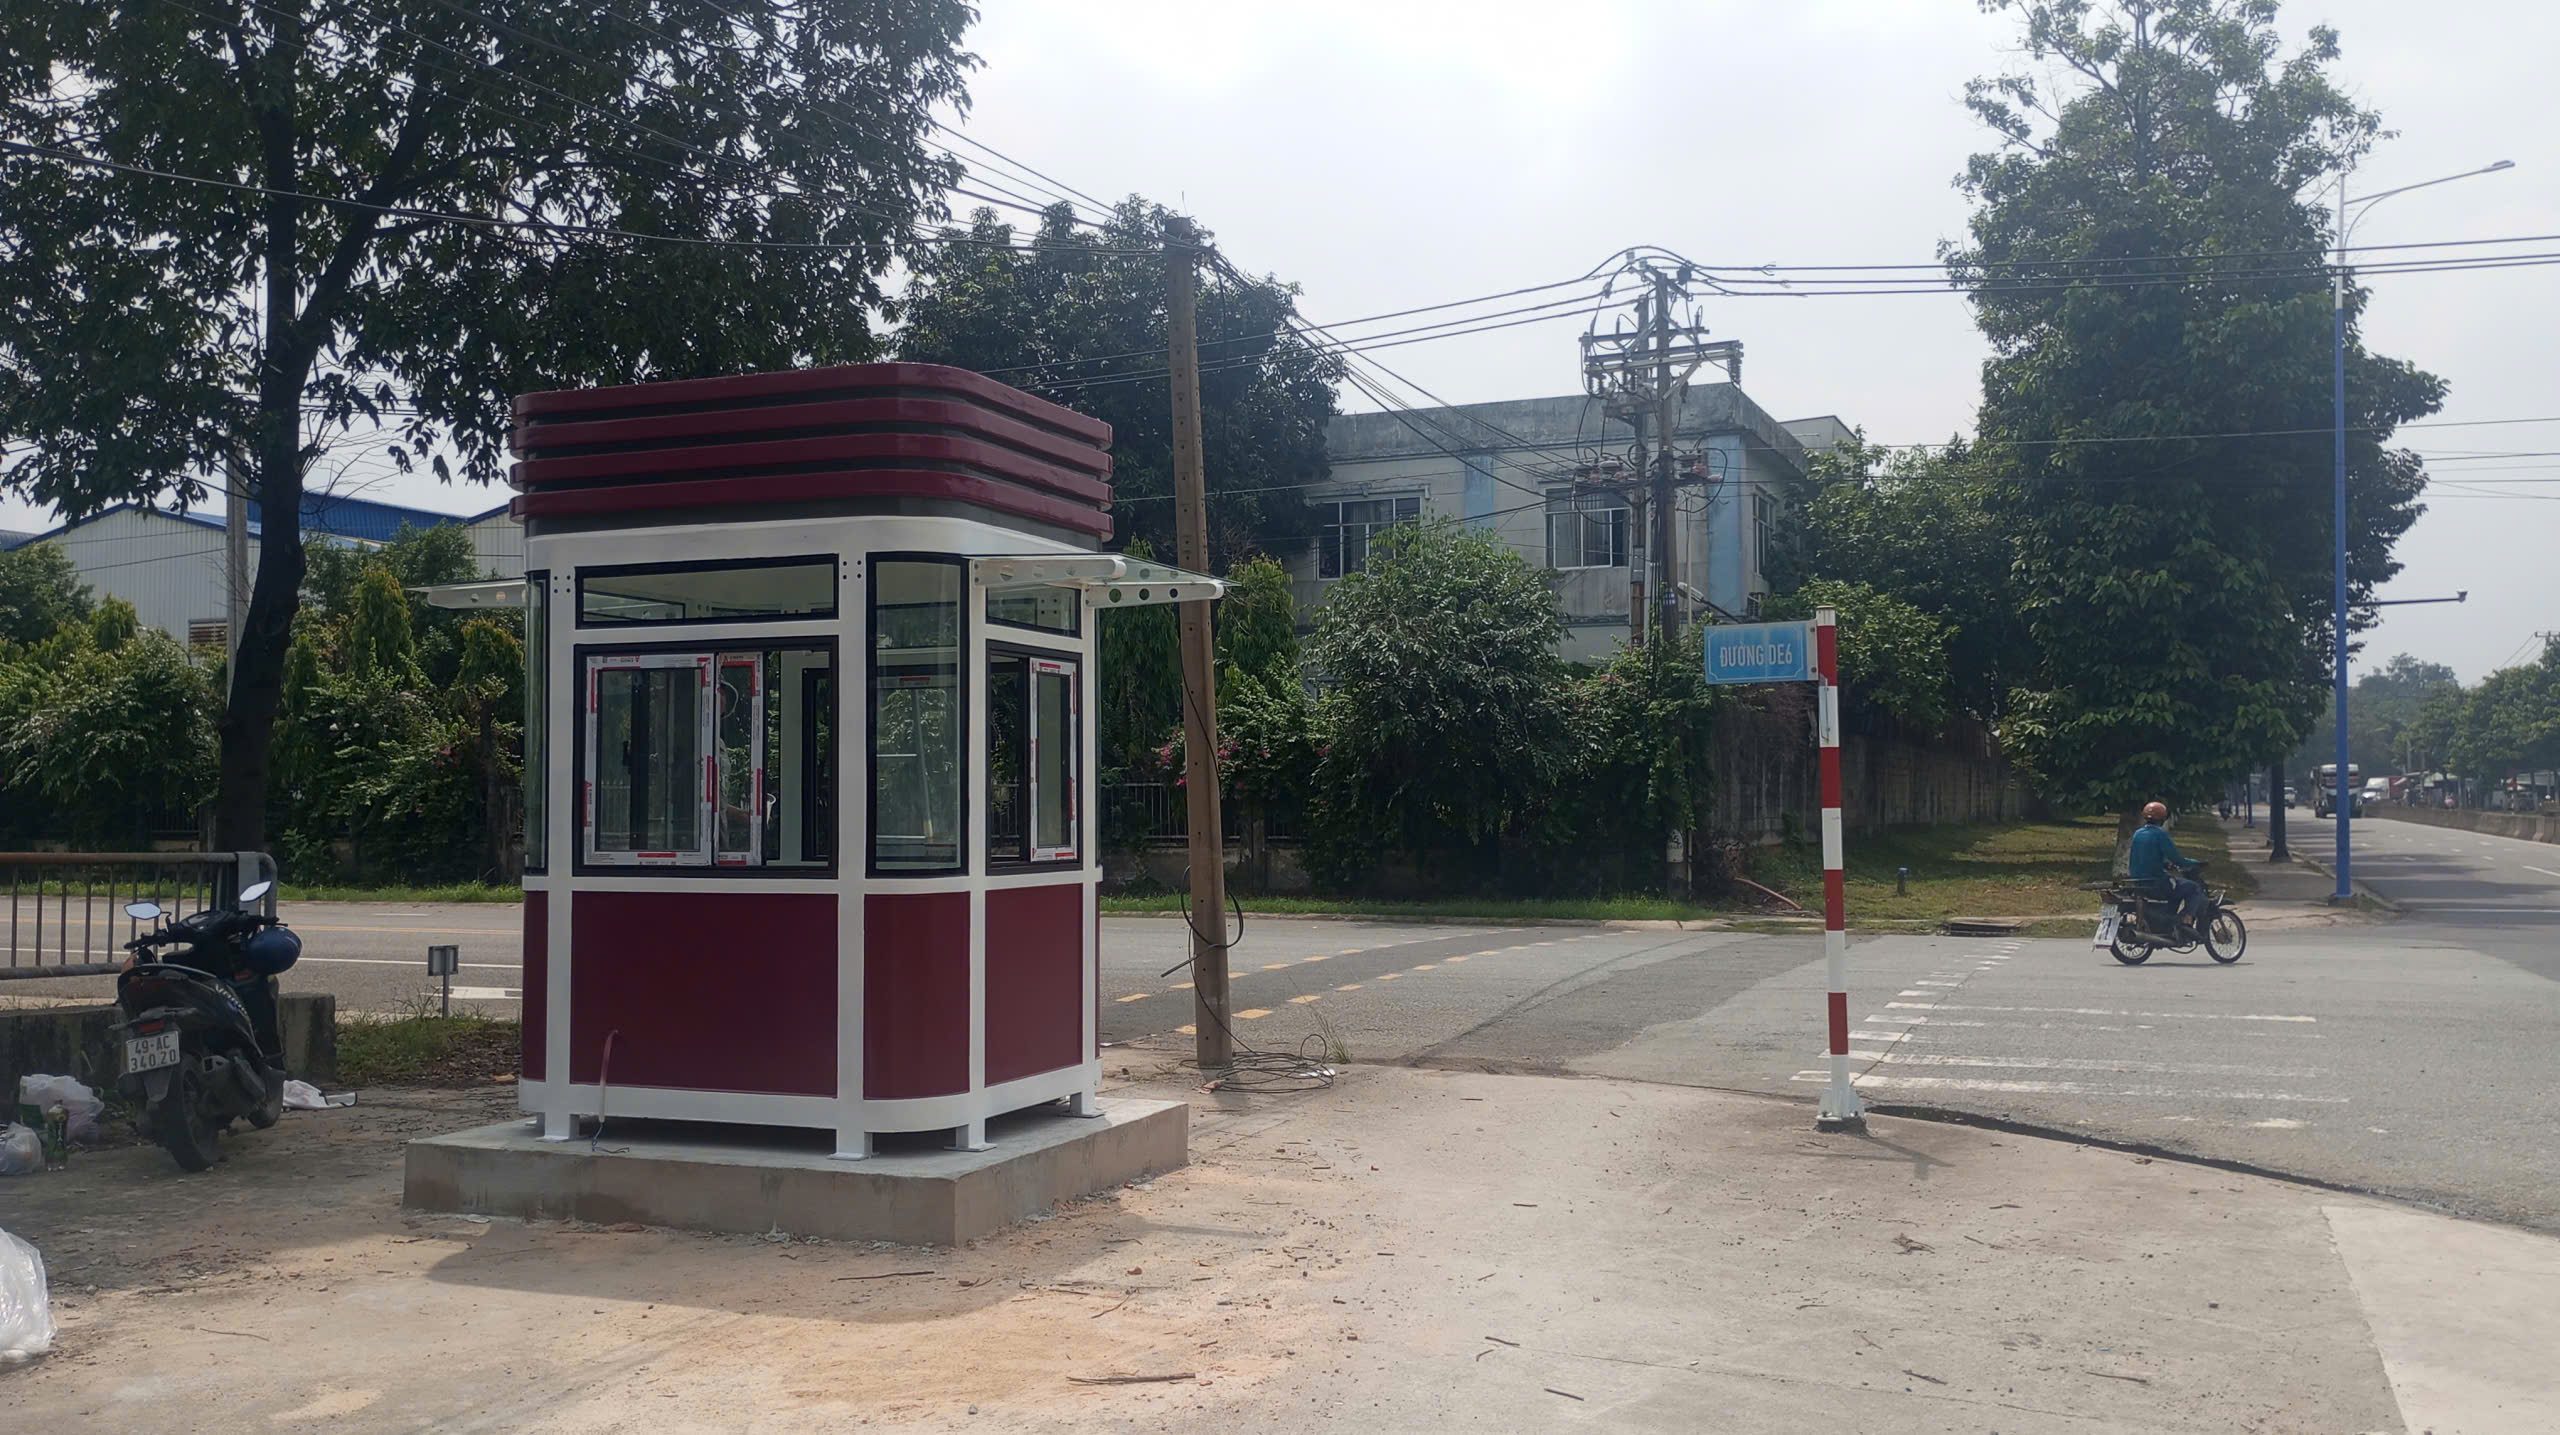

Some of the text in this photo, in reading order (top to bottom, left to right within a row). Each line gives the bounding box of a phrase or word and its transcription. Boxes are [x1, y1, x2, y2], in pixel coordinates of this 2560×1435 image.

[1720, 641, 1793, 667] ĐƯỜNG DE6
[135, 1036, 170, 1054] 49-AC
